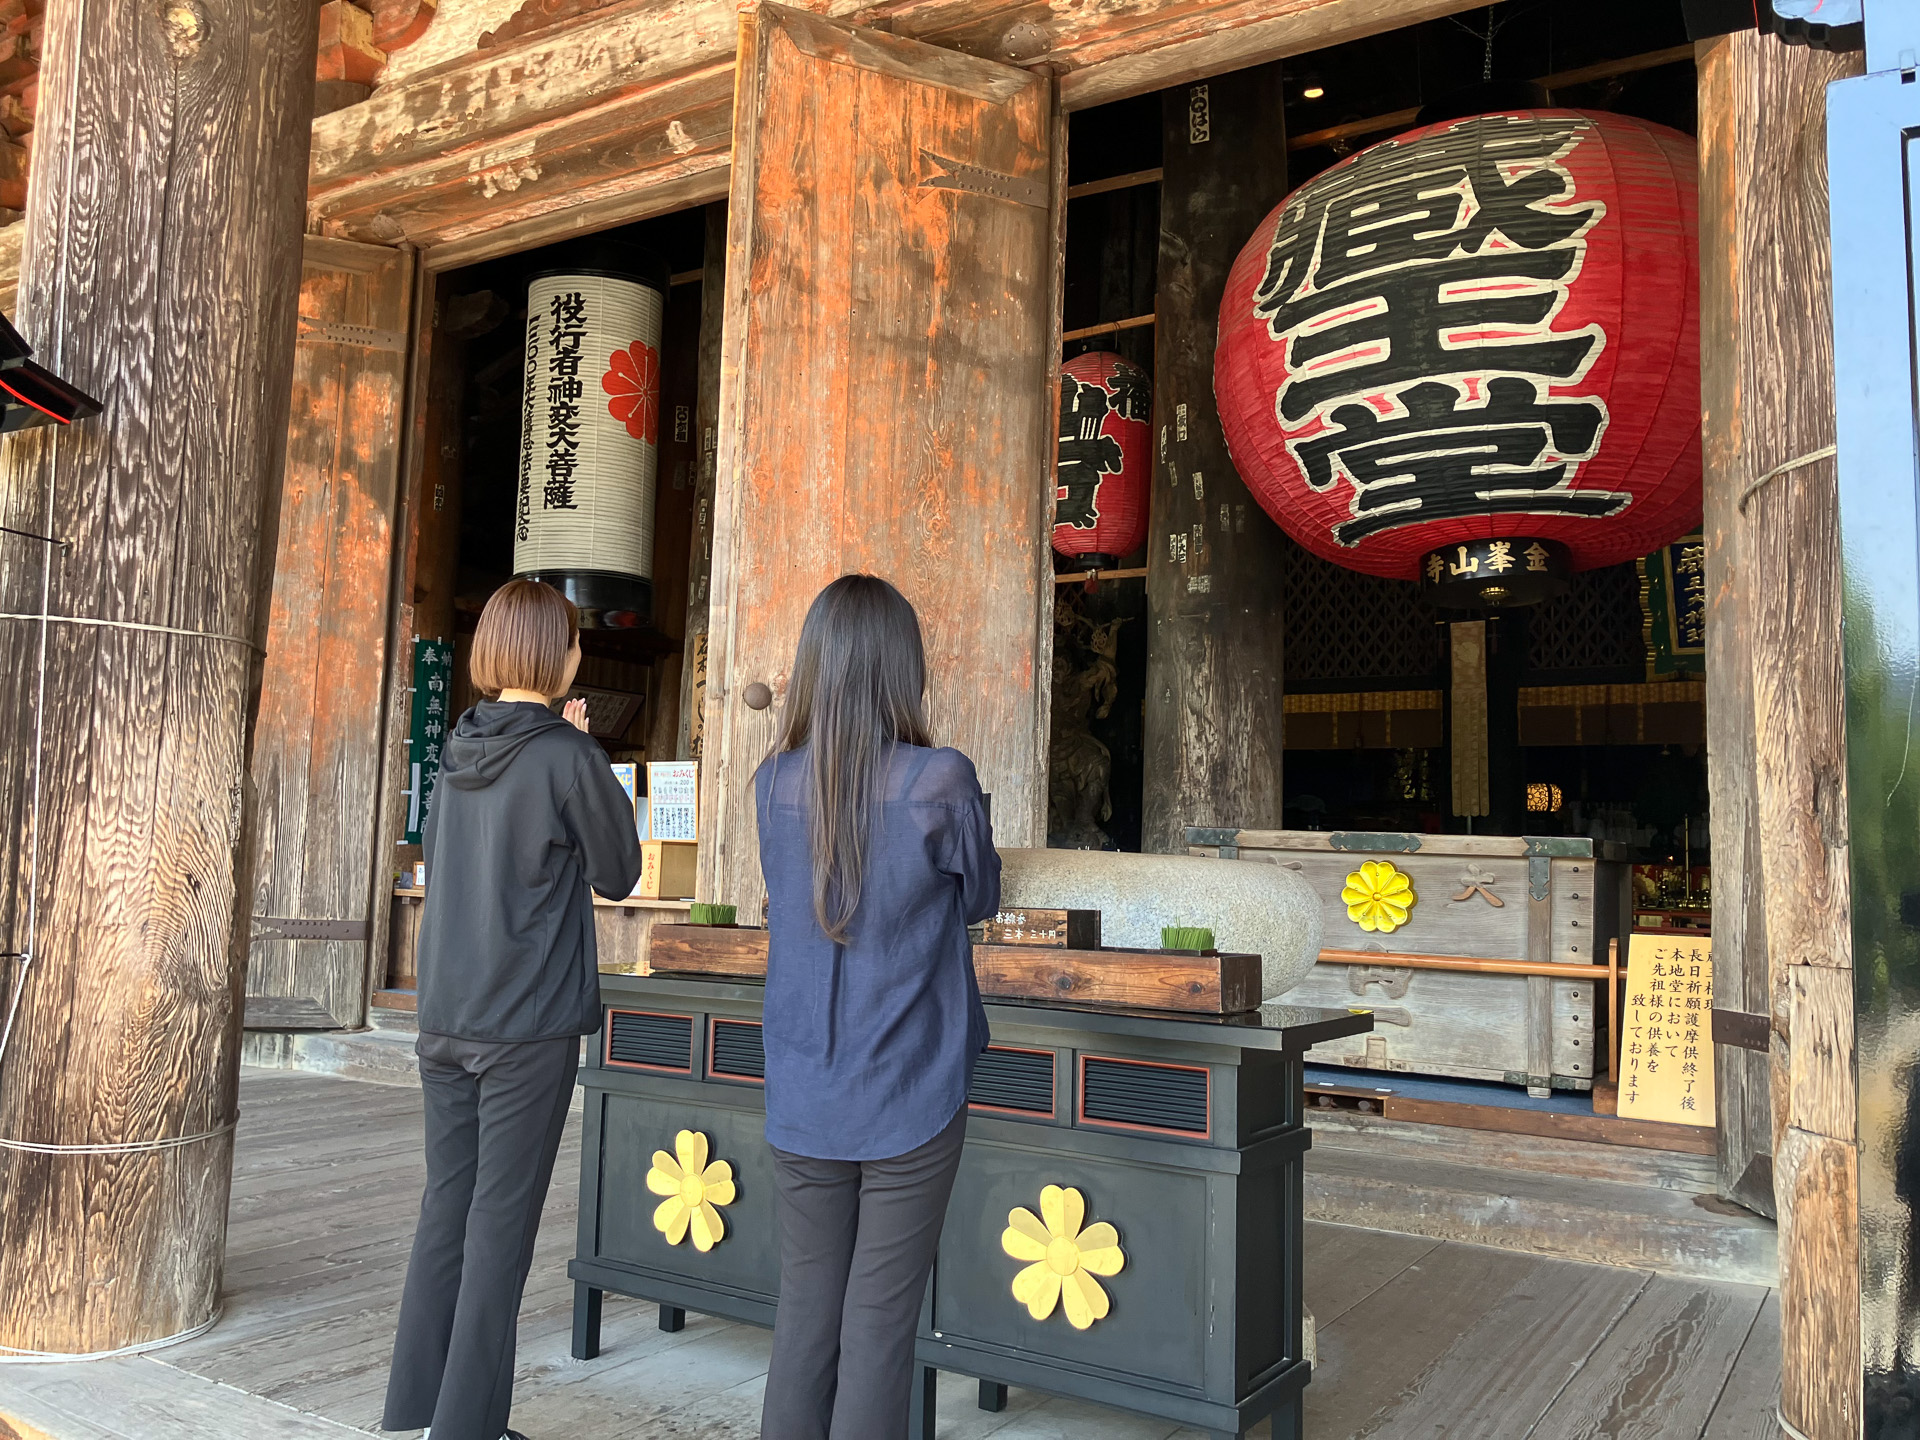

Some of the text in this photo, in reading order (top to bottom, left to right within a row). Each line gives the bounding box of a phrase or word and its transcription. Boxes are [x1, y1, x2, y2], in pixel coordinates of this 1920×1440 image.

[1426, 541, 1550, 584] 金峯山寺
[647, 852, 656, 890] おみくじ
[1003, 928, 1056, 940] 三本 三十円
[1625, 993, 1646, 1105] 致しております
[1646, 948, 1668, 1074] ご先祖様の供養を
[1665, 947, 1686, 1059] 本地堂において
[1680, 948, 1704, 1111] 長日祈願護摩供終了後
